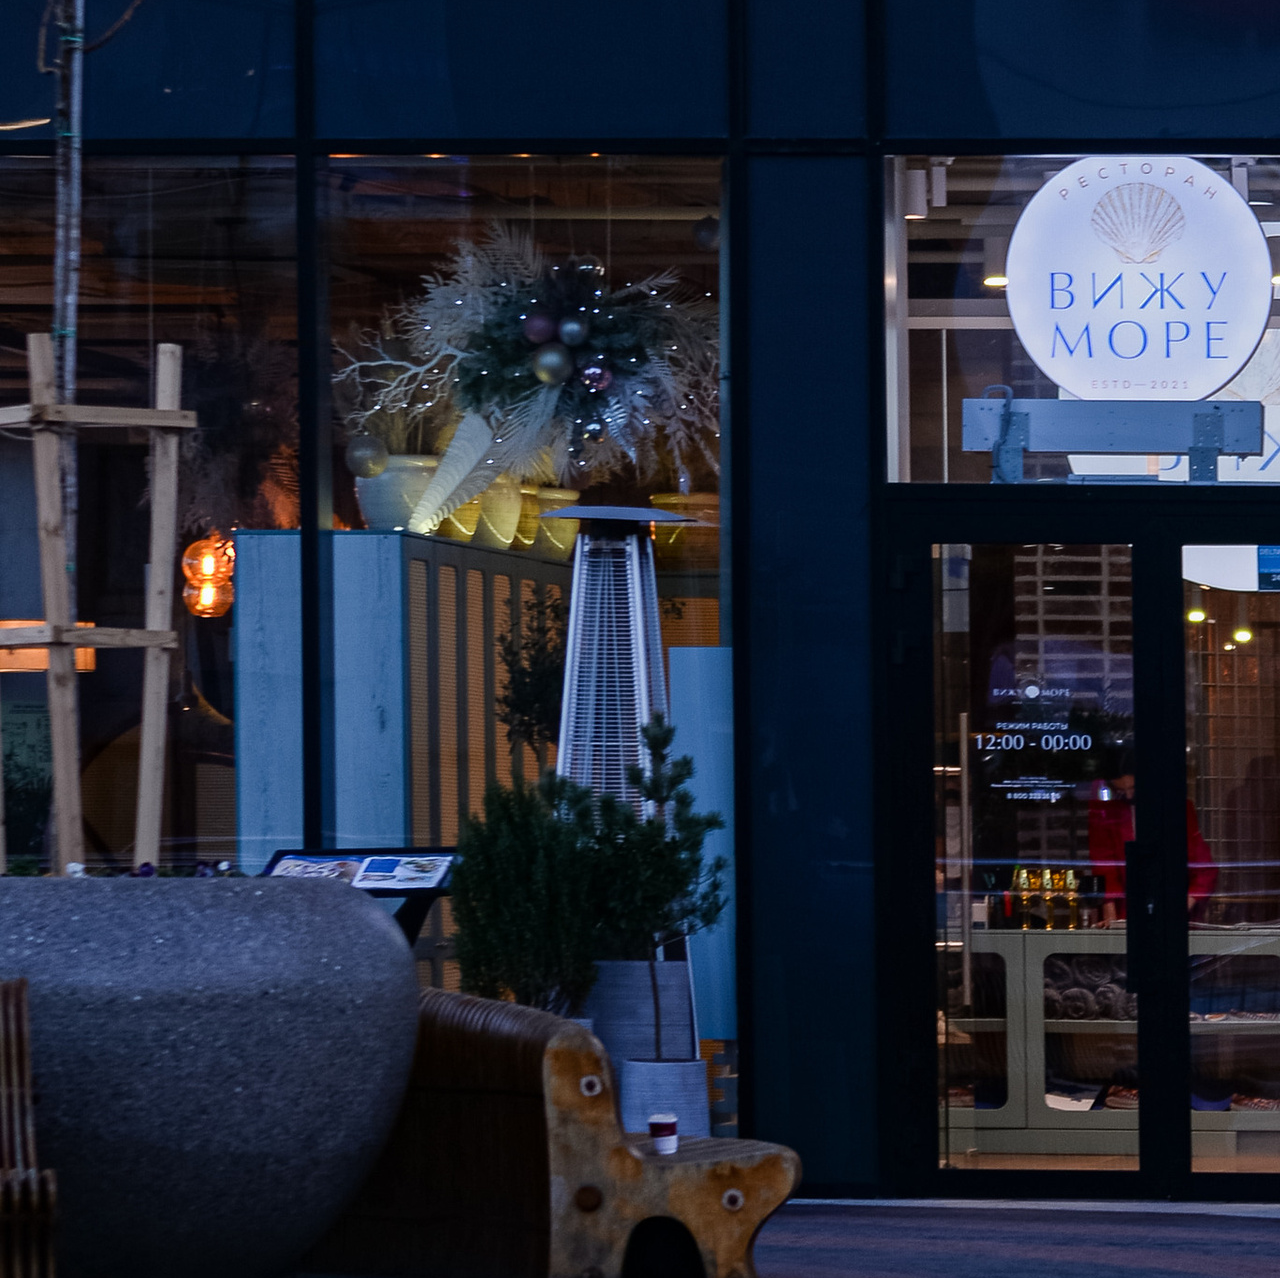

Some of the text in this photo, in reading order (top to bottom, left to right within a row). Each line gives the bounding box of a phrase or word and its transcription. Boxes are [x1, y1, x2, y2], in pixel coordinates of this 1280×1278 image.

[1058, 162, 1218, 201] РЕСТОРАН
[1049, 271, 1228, 310] ВИЖУ
[1050, 320, 1229, 359] МОРЕ
[975, 734, 1024, 750] 12:00
[1041, 734, 1092, 750] 00:00
[996, 722, 1068, 730] РЕЖИМ РАБОТЫ
